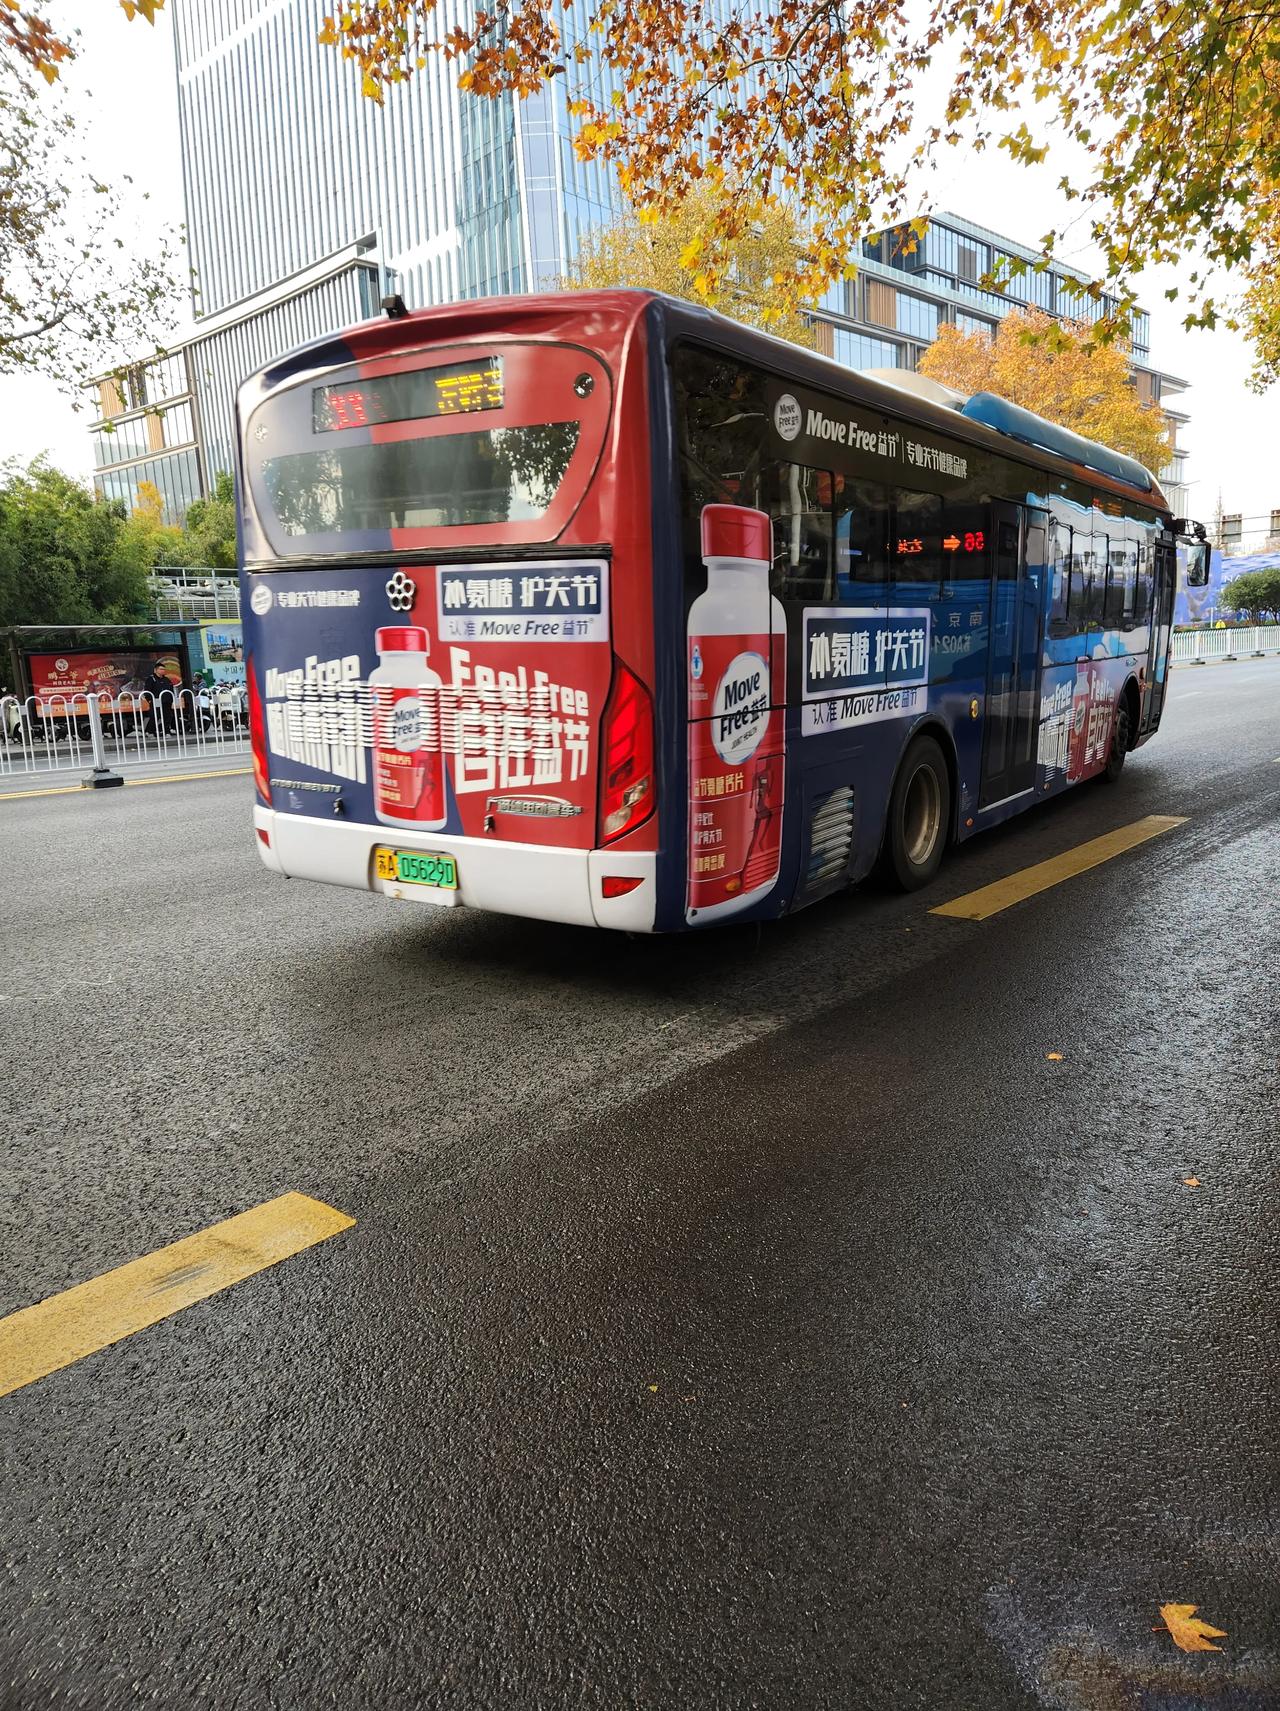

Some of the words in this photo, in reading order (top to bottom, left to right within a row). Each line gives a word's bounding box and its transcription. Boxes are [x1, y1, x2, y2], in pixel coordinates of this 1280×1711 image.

[806, 409, 847, 444] Move
[848, 421, 877, 452] Free
[878, 431, 897, 458] 益节
[906, 440, 967, 480] 专业关节健康品牌
[277, 589, 361, 608] 专业关节健康品牌
[443, 578, 513, 608] 补氨糖
[520, 574, 598, 608] 护关节
[480, 620, 521, 636] Move
[524, 620, 560, 636] Free
[809, 630, 870, 680] 补氨糖
[875, 628, 925, 673] 护关节
[450, 646, 529, 706] Feel
[534, 670, 590, 717] Free
[724, 672, 760, 711] Move
[720, 705, 750, 742] Free
[812, 701, 837, 725] 认准
[840, 697, 874, 720] Move
[875, 691, 900, 713] Free
